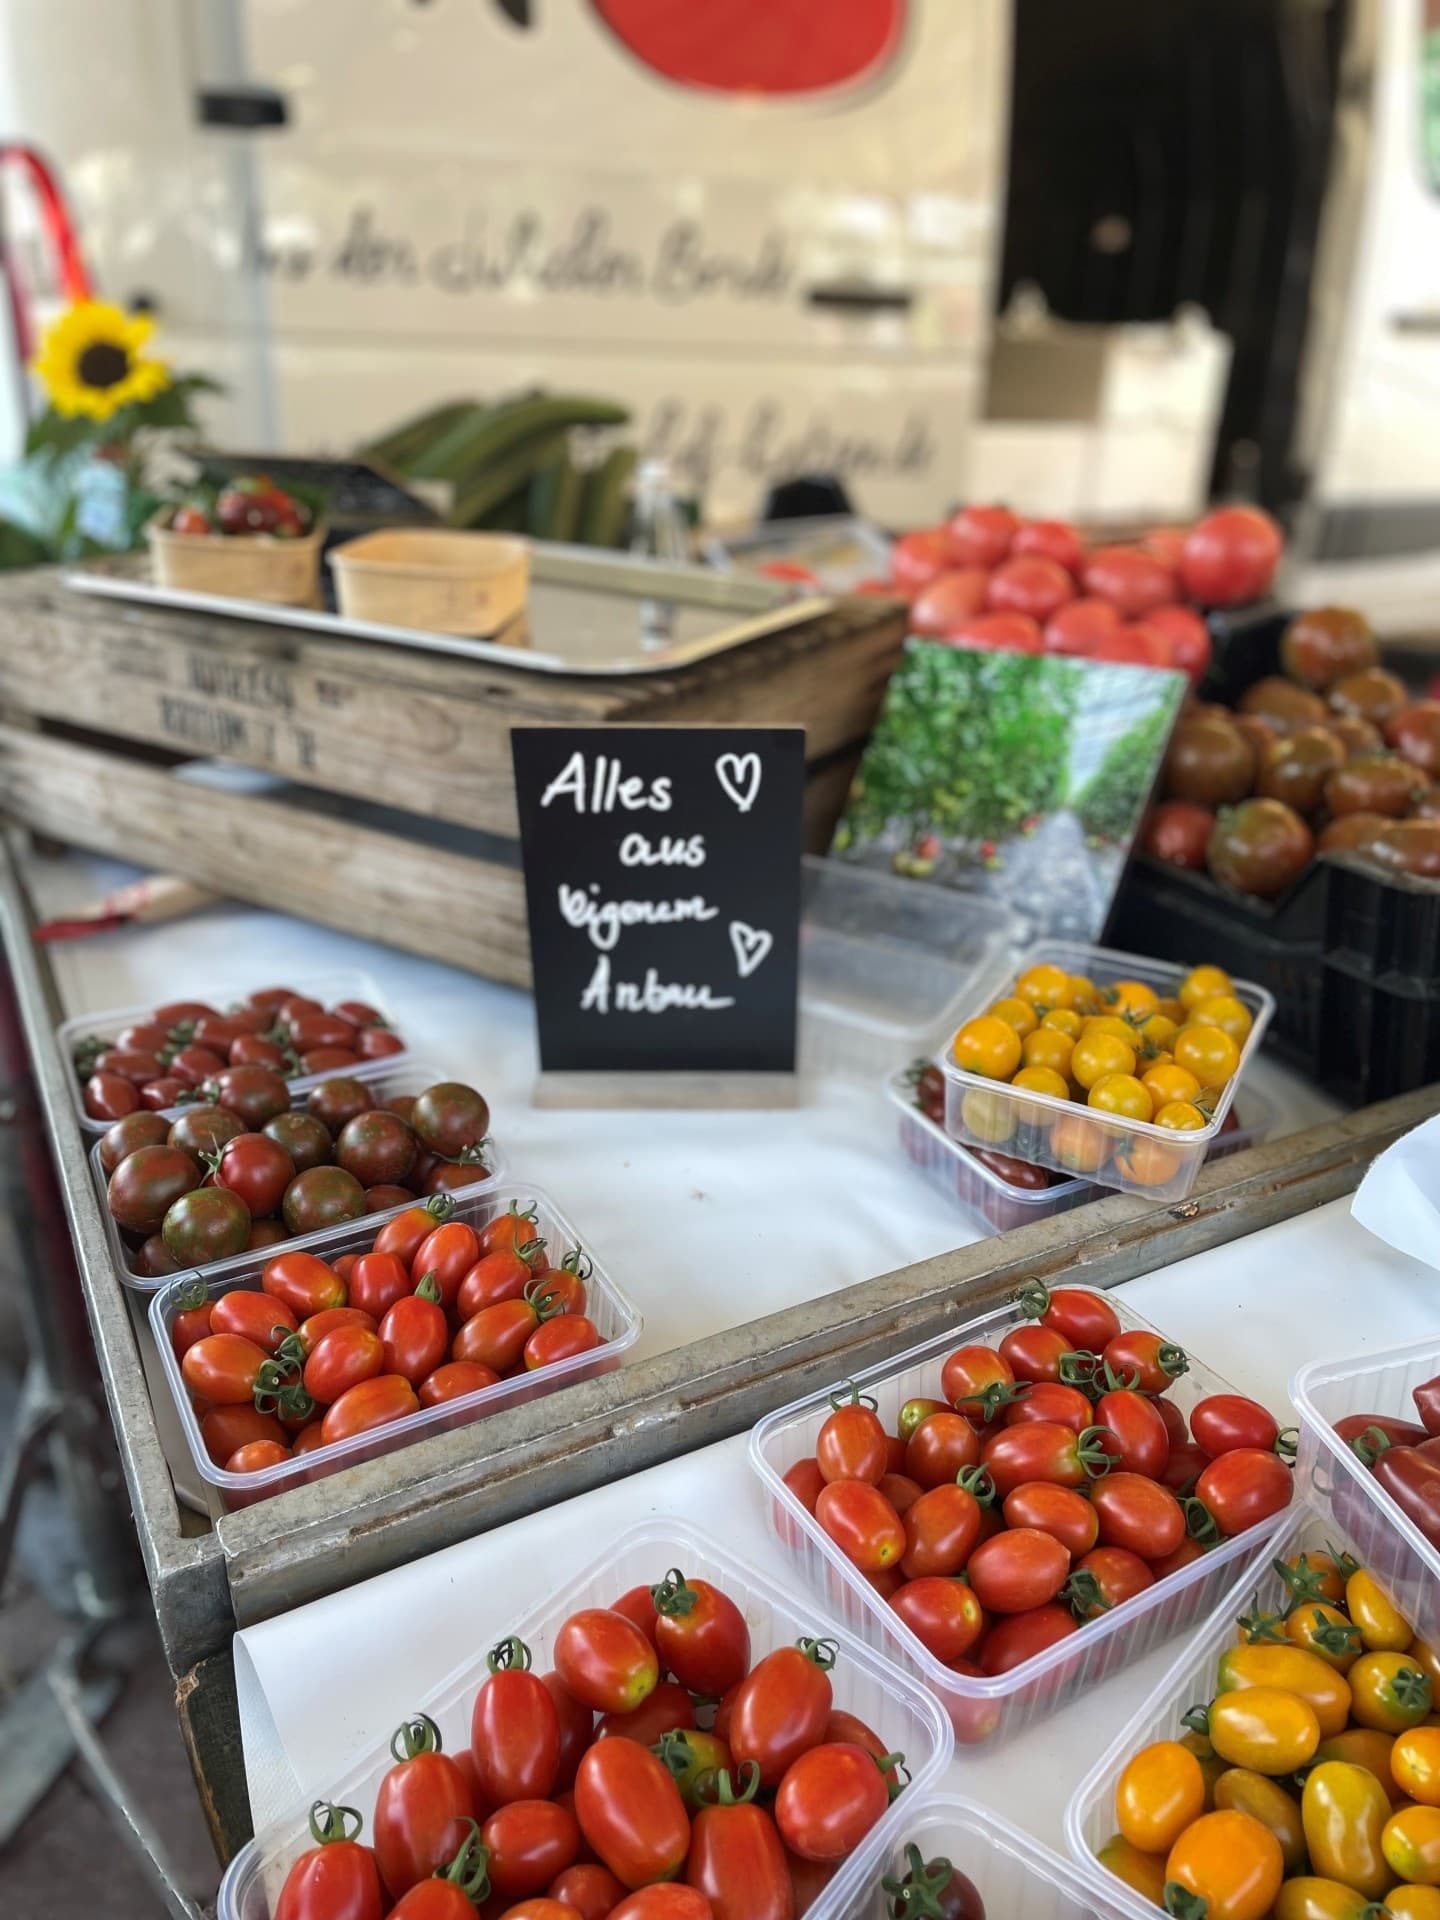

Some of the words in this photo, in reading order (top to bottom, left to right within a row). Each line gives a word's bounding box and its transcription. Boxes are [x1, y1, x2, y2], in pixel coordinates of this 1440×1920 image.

[541, 752, 672, 813] Alles
[619, 833, 706, 867] aus
[580, 955, 734, 1013] Anbau
